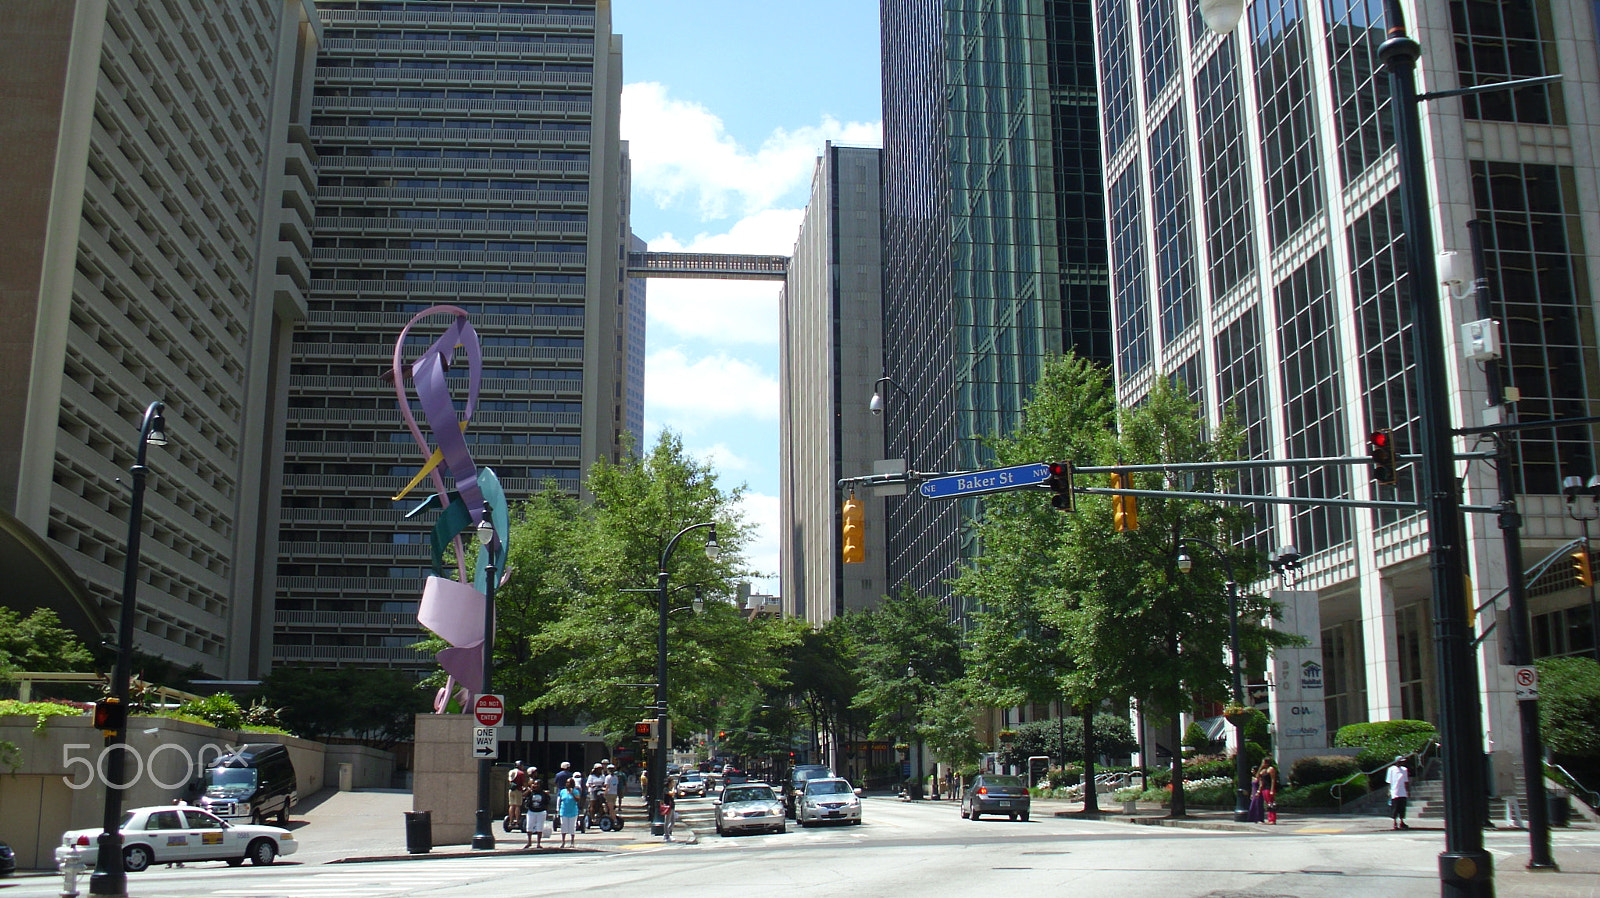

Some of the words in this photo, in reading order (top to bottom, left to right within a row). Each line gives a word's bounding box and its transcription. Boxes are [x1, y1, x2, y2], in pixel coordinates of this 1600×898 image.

[924, 485, 936, 493] NE
[957, 476, 995, 491] Baker
[1000, 472, 1013, 484] St
[1033, 468, 1048, 478] NW
[477, 729, 494, 737] ONE
[477, 737, 494, 745] WAY
